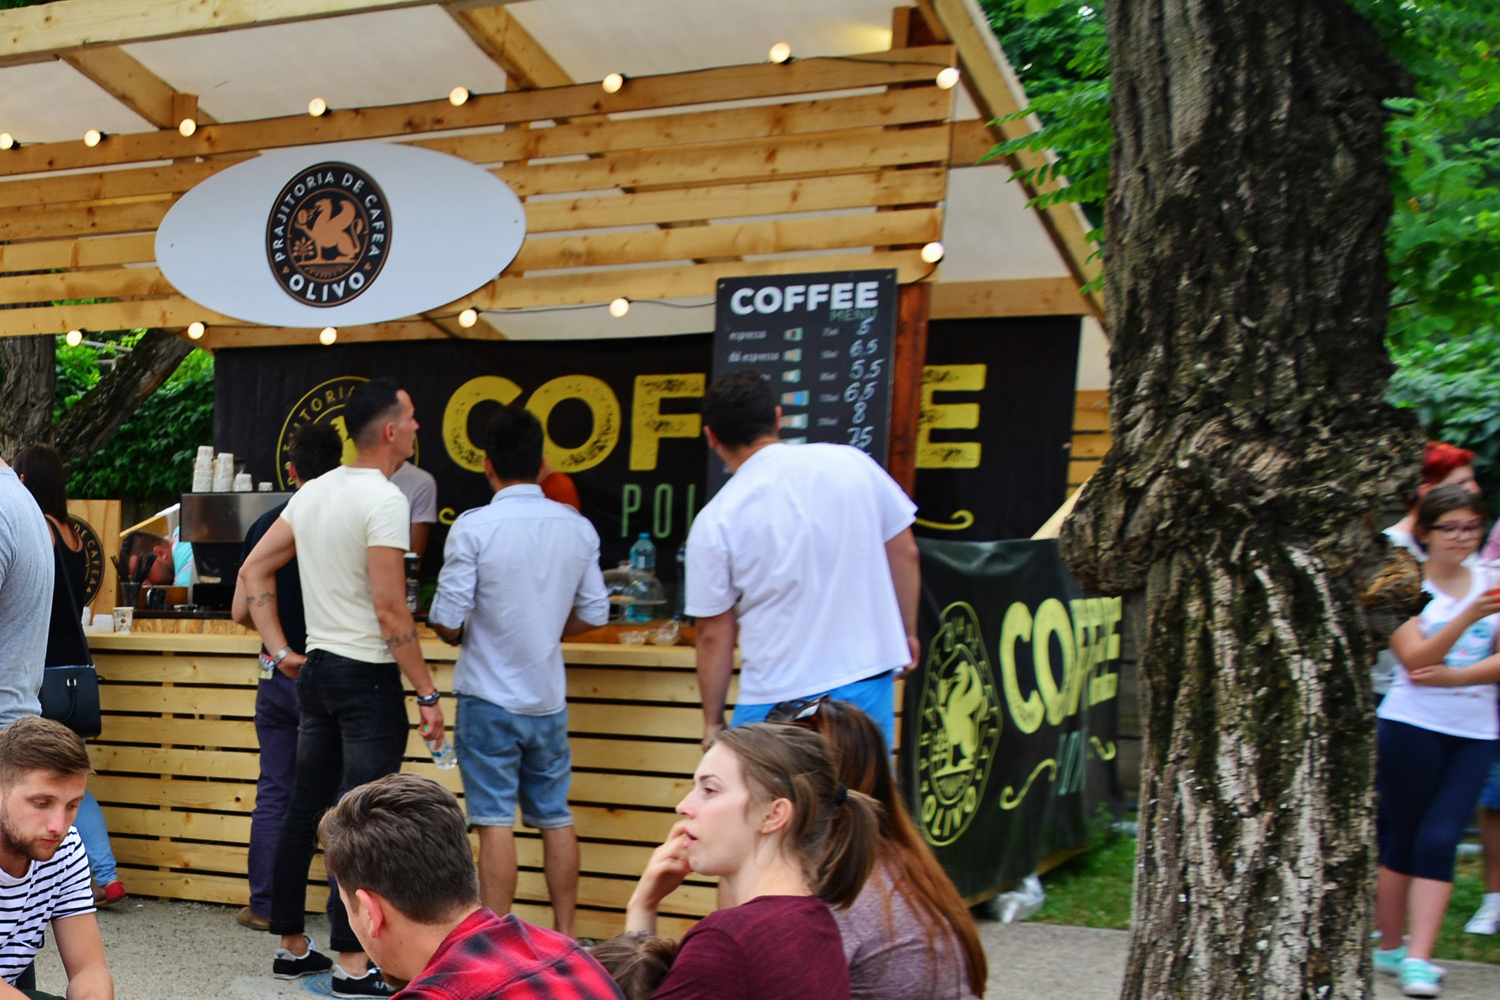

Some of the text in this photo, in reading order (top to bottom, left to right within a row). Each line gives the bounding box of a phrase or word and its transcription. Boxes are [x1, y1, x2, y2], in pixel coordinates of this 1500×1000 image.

[272, 171, 385, 262] PRAJITORIA DE CAFEA
[289, 271, 365, 302] OLIVO
[730, 281, 879, 316] COFFEE
[829, 309, 878, 322] MENU
[852, 401, 867, 424] 8
[621, 483, 696, 538] POI
[88, 540, 100, 585] CAFEA
[922, 786, 977, 837] OLIVO
